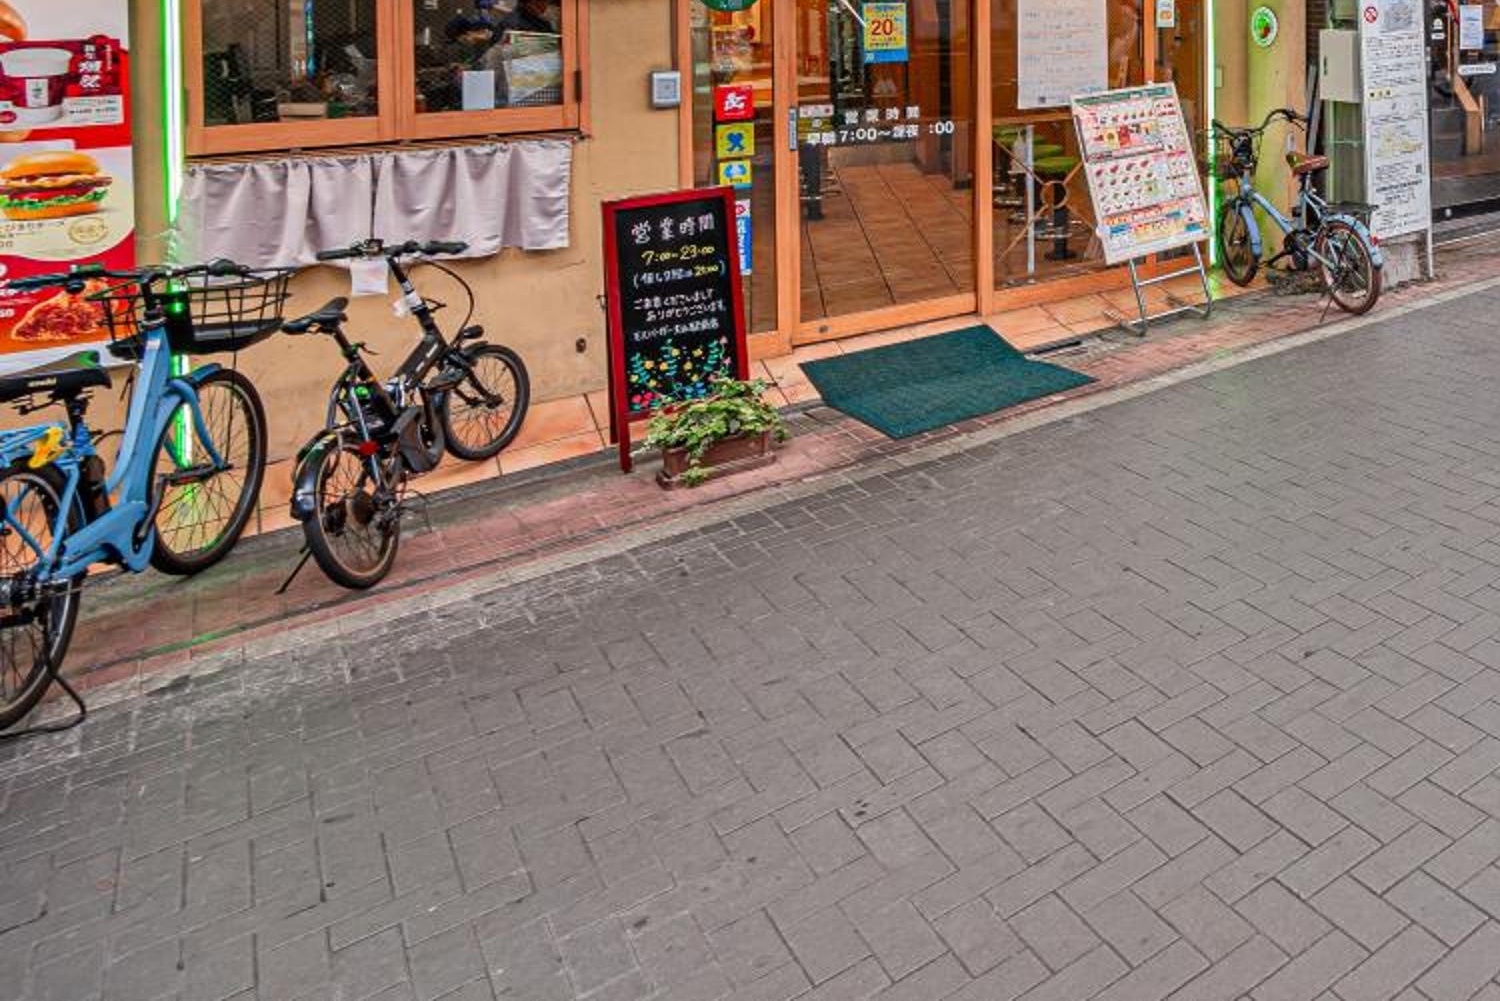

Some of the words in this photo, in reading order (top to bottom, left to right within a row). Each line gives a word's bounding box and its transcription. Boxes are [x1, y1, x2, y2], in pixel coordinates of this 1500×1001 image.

[871, 18, 893, 35] 20
[631, 212, 715, 245] 営業時間
